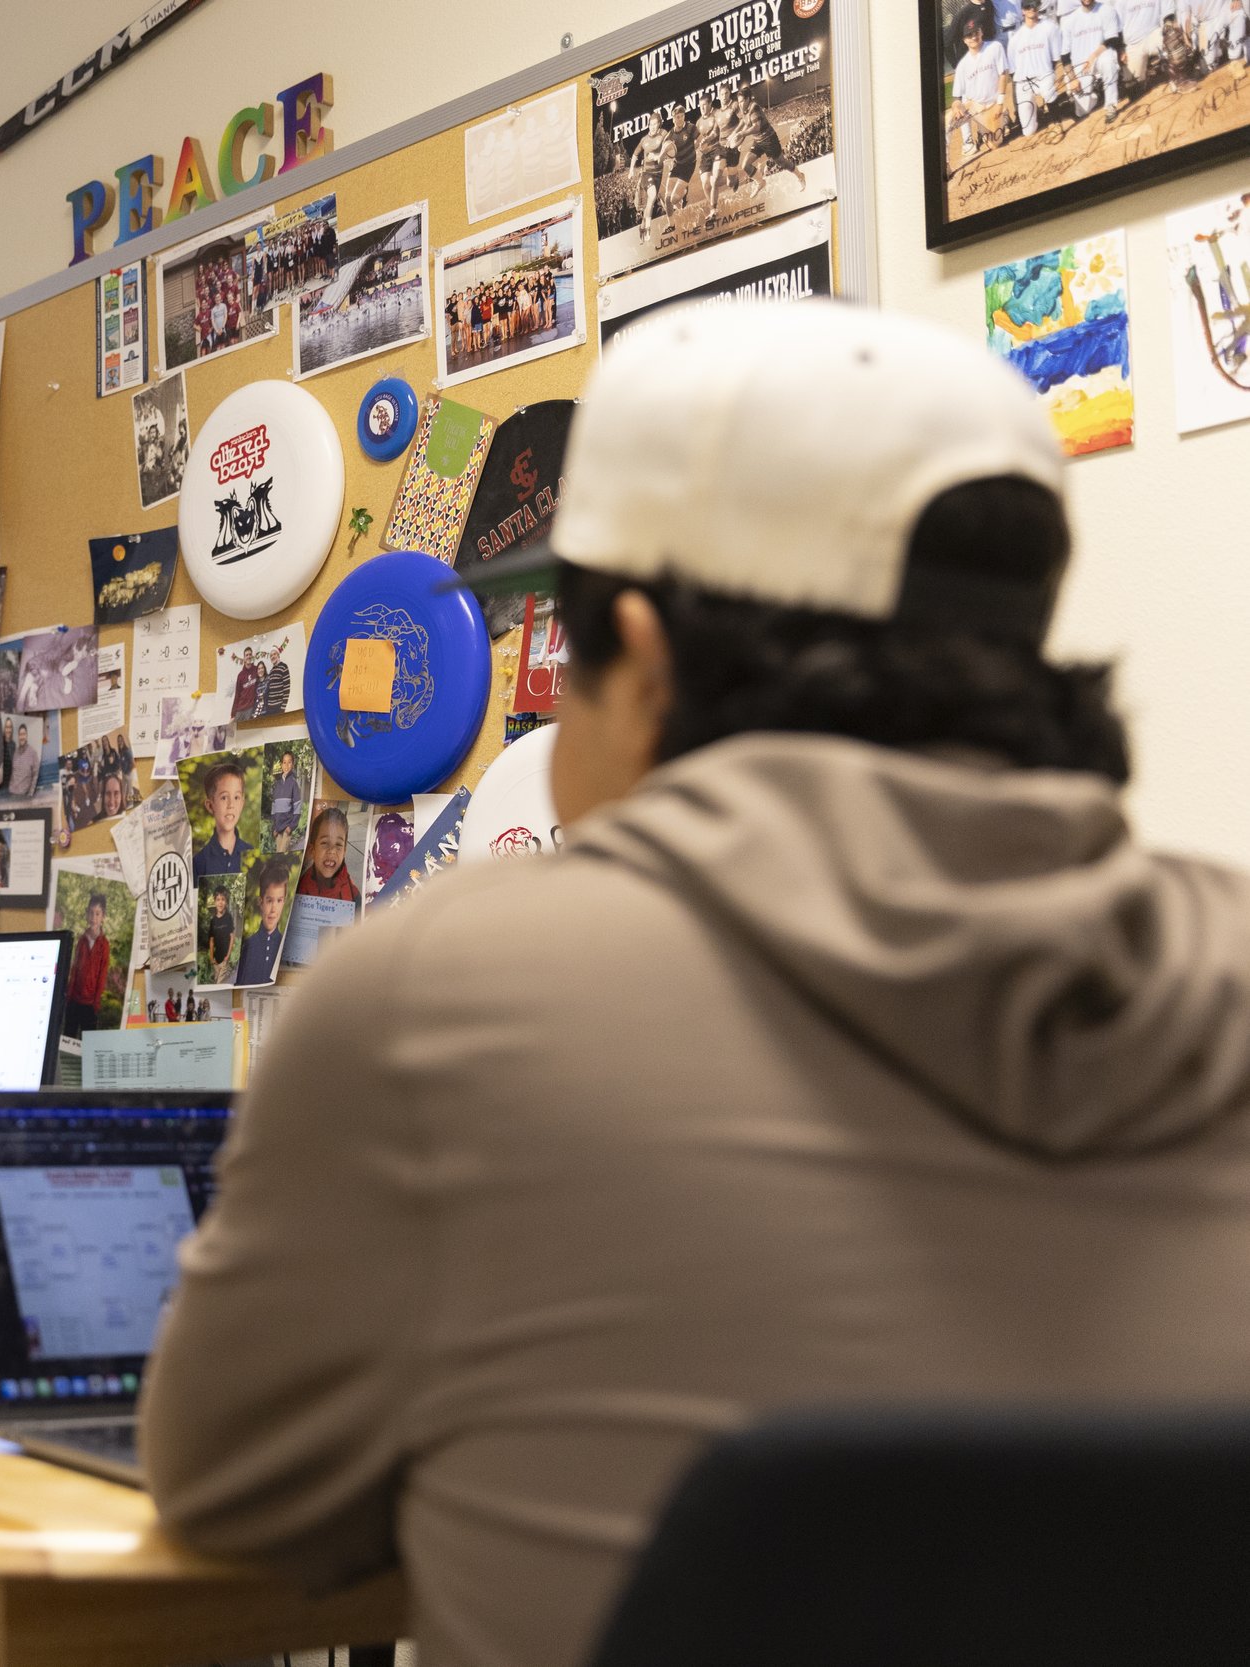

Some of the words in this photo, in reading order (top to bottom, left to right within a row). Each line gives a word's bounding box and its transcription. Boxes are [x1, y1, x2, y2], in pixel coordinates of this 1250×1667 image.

[640, 29, 701, 86] MEN'S
[710, 0, 782, 53] RUGBY
[708, 62, 730, 80] Friday,
[731, 56, 743, 69] Feb
[754, 49, 764, 60] @
[766, 40, 782, 55] 8PM
[724, 49, 736, 61] vs
[739, 26, 782, 55] Stanford
[749, 41, 823, 86] LIGHTS
[23, 27, 141, 126] CCM
[783, 68, 805, 82] Bellomy
[806, 61, 821, 74] Field
[65, 72, 335, 268] PEACE
[655, 233, 680, 251] JOIN
[681, 223, 702, 241] THE
[704, 202, 766, 232] STAMPEDE
[212, 428, 268, 469] altered
[219, 450, 264, 482] beast
[477, 503, 538, 561] SANTA
[316, 901, 335, 912] Tigers
